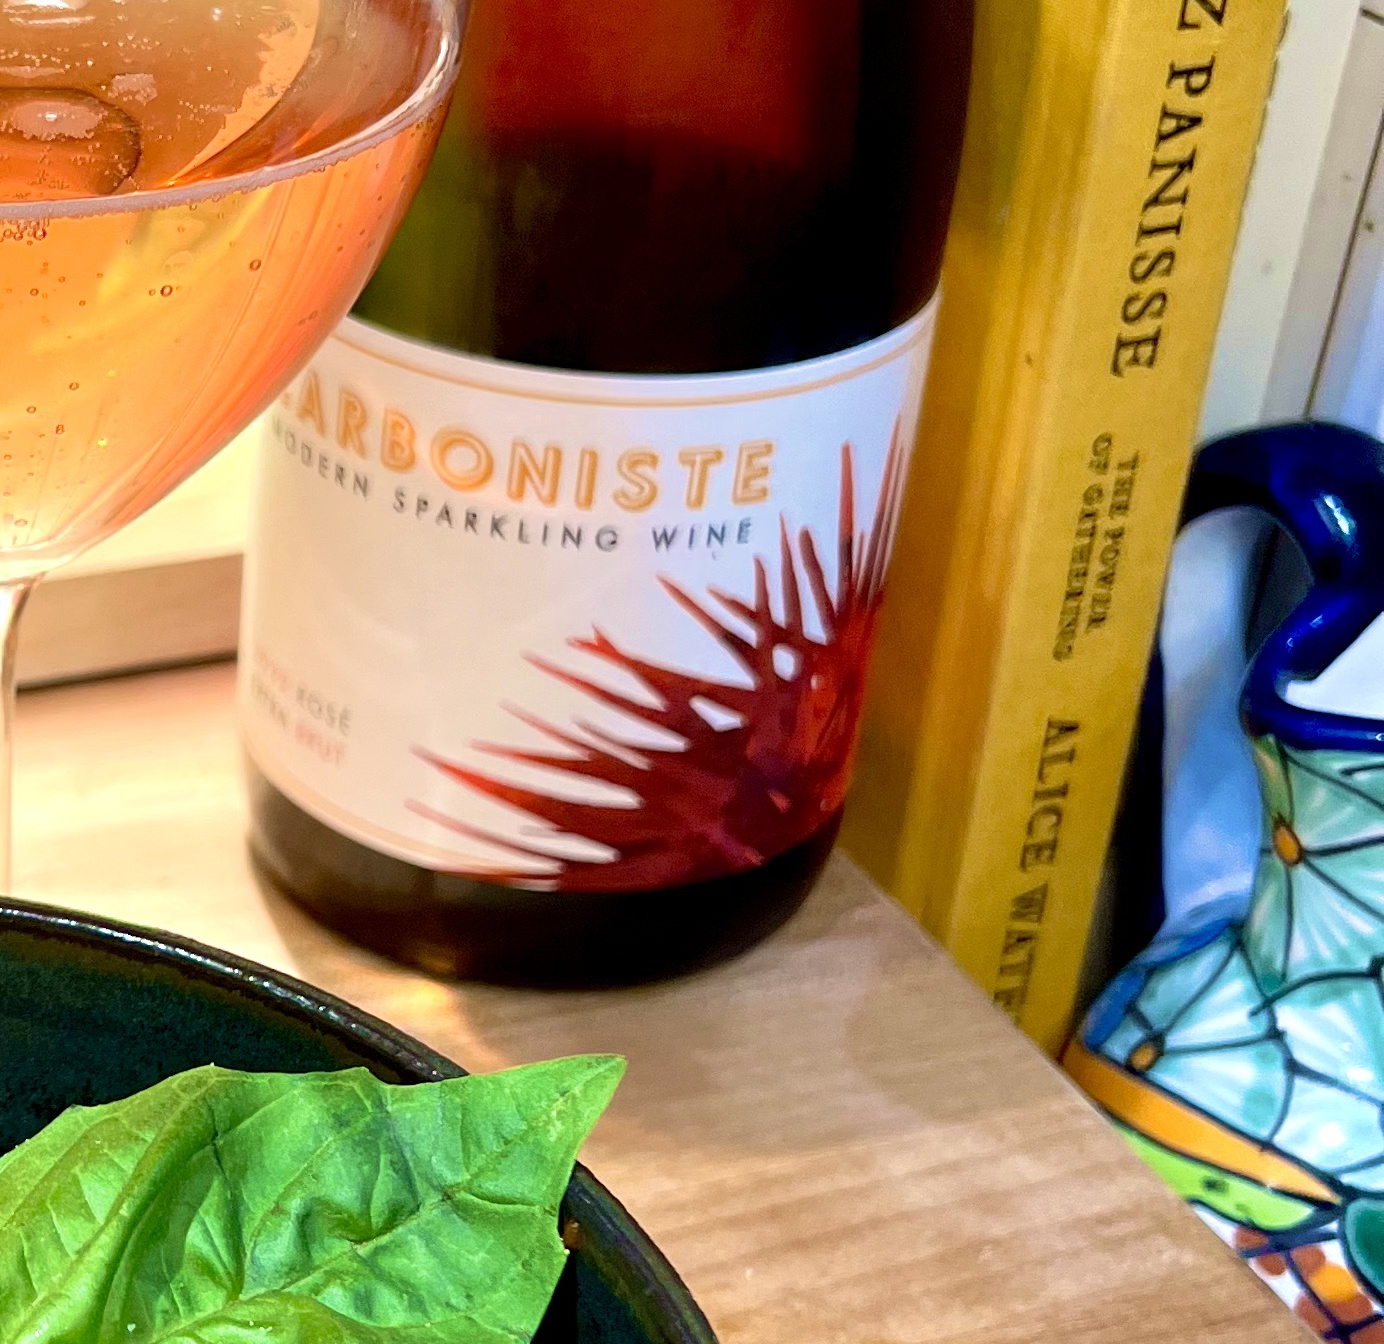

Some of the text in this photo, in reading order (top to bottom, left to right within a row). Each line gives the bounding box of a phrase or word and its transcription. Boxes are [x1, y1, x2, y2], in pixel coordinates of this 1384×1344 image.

[1112, 55, 1216, 379] PANISSE
[280, 368, 774, 513] ARBONISTE
[392, 485, 621, 554] SPARKLING
[651, 517, 754, 552] WINE
[1087, 432, 1114, 475] OF
[1086, 450, 1141, 634] THE POWER
[992, 715, 1081, 1024] ALICE WATE
